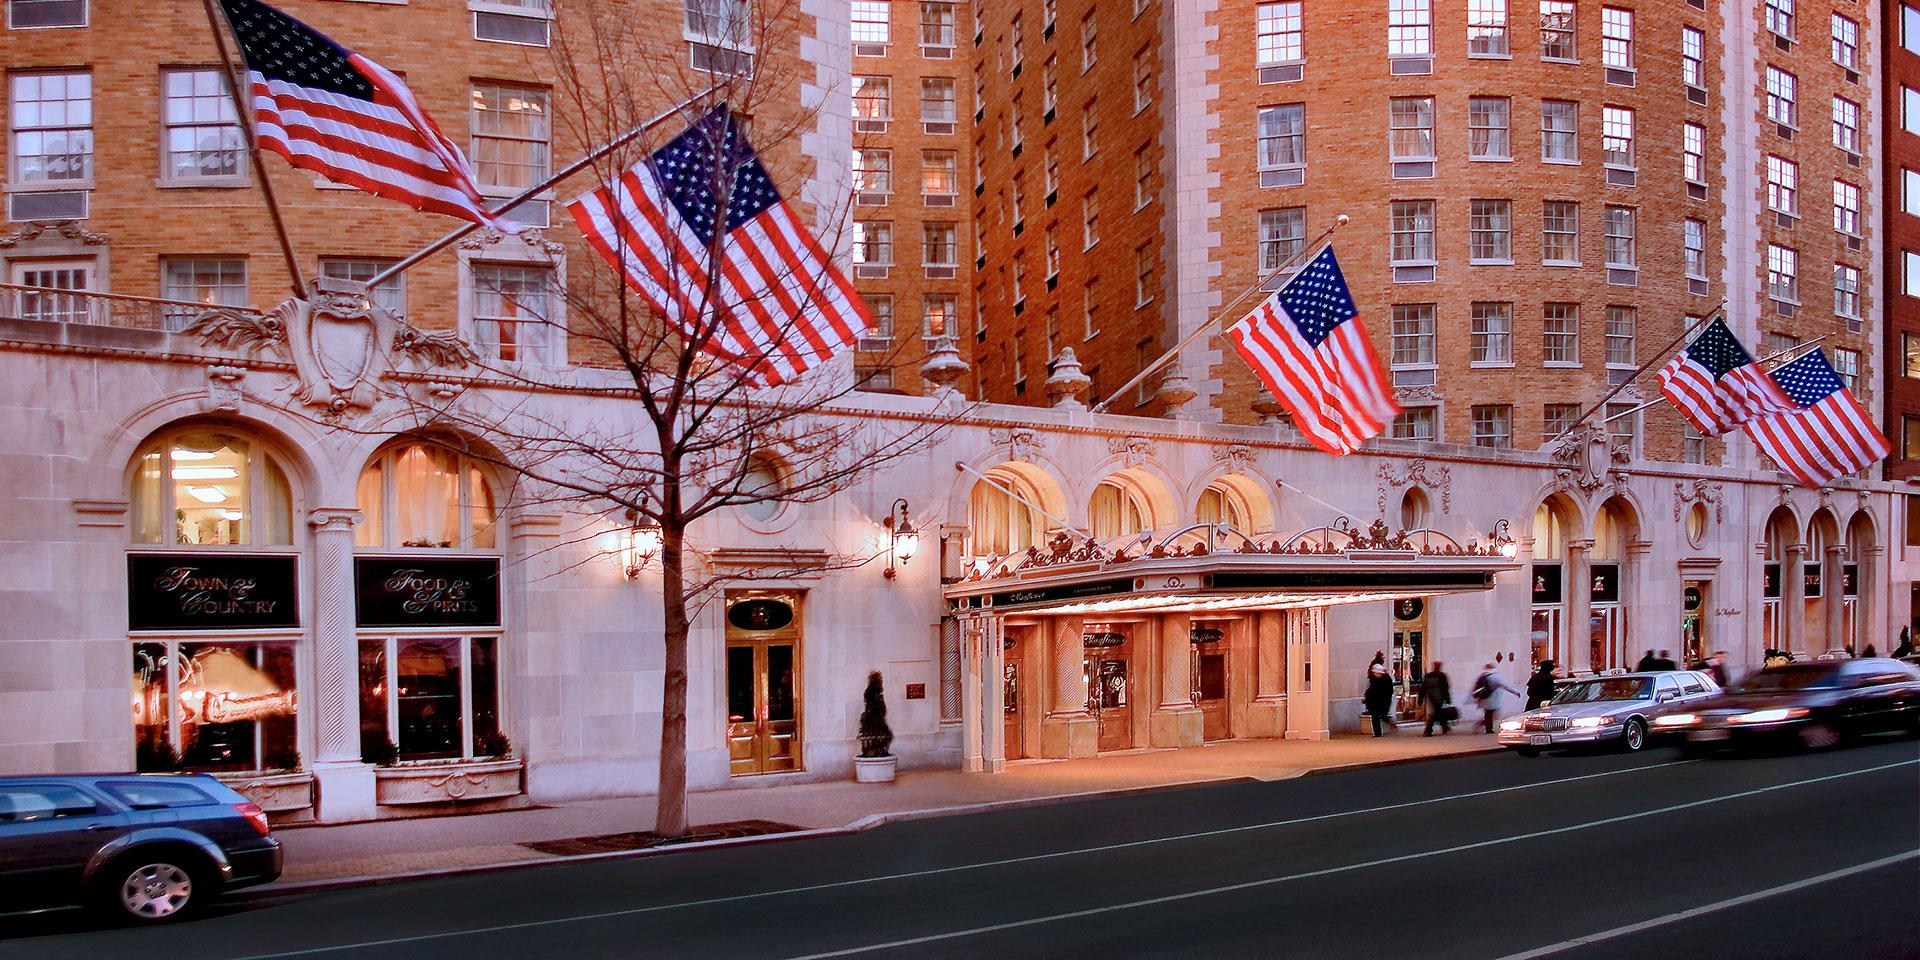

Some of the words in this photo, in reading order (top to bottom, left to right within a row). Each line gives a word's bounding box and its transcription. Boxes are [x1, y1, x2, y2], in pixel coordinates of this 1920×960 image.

[154, 567, 228, 591] TOWN
[229, 579, 256, 600] &
[385, 569, 447, 592] FOOD
[448, 580, 471, 599] &
[180, 591, 276, 615] COUNTRY
[403, 591, 478, 613] SPIRITS
